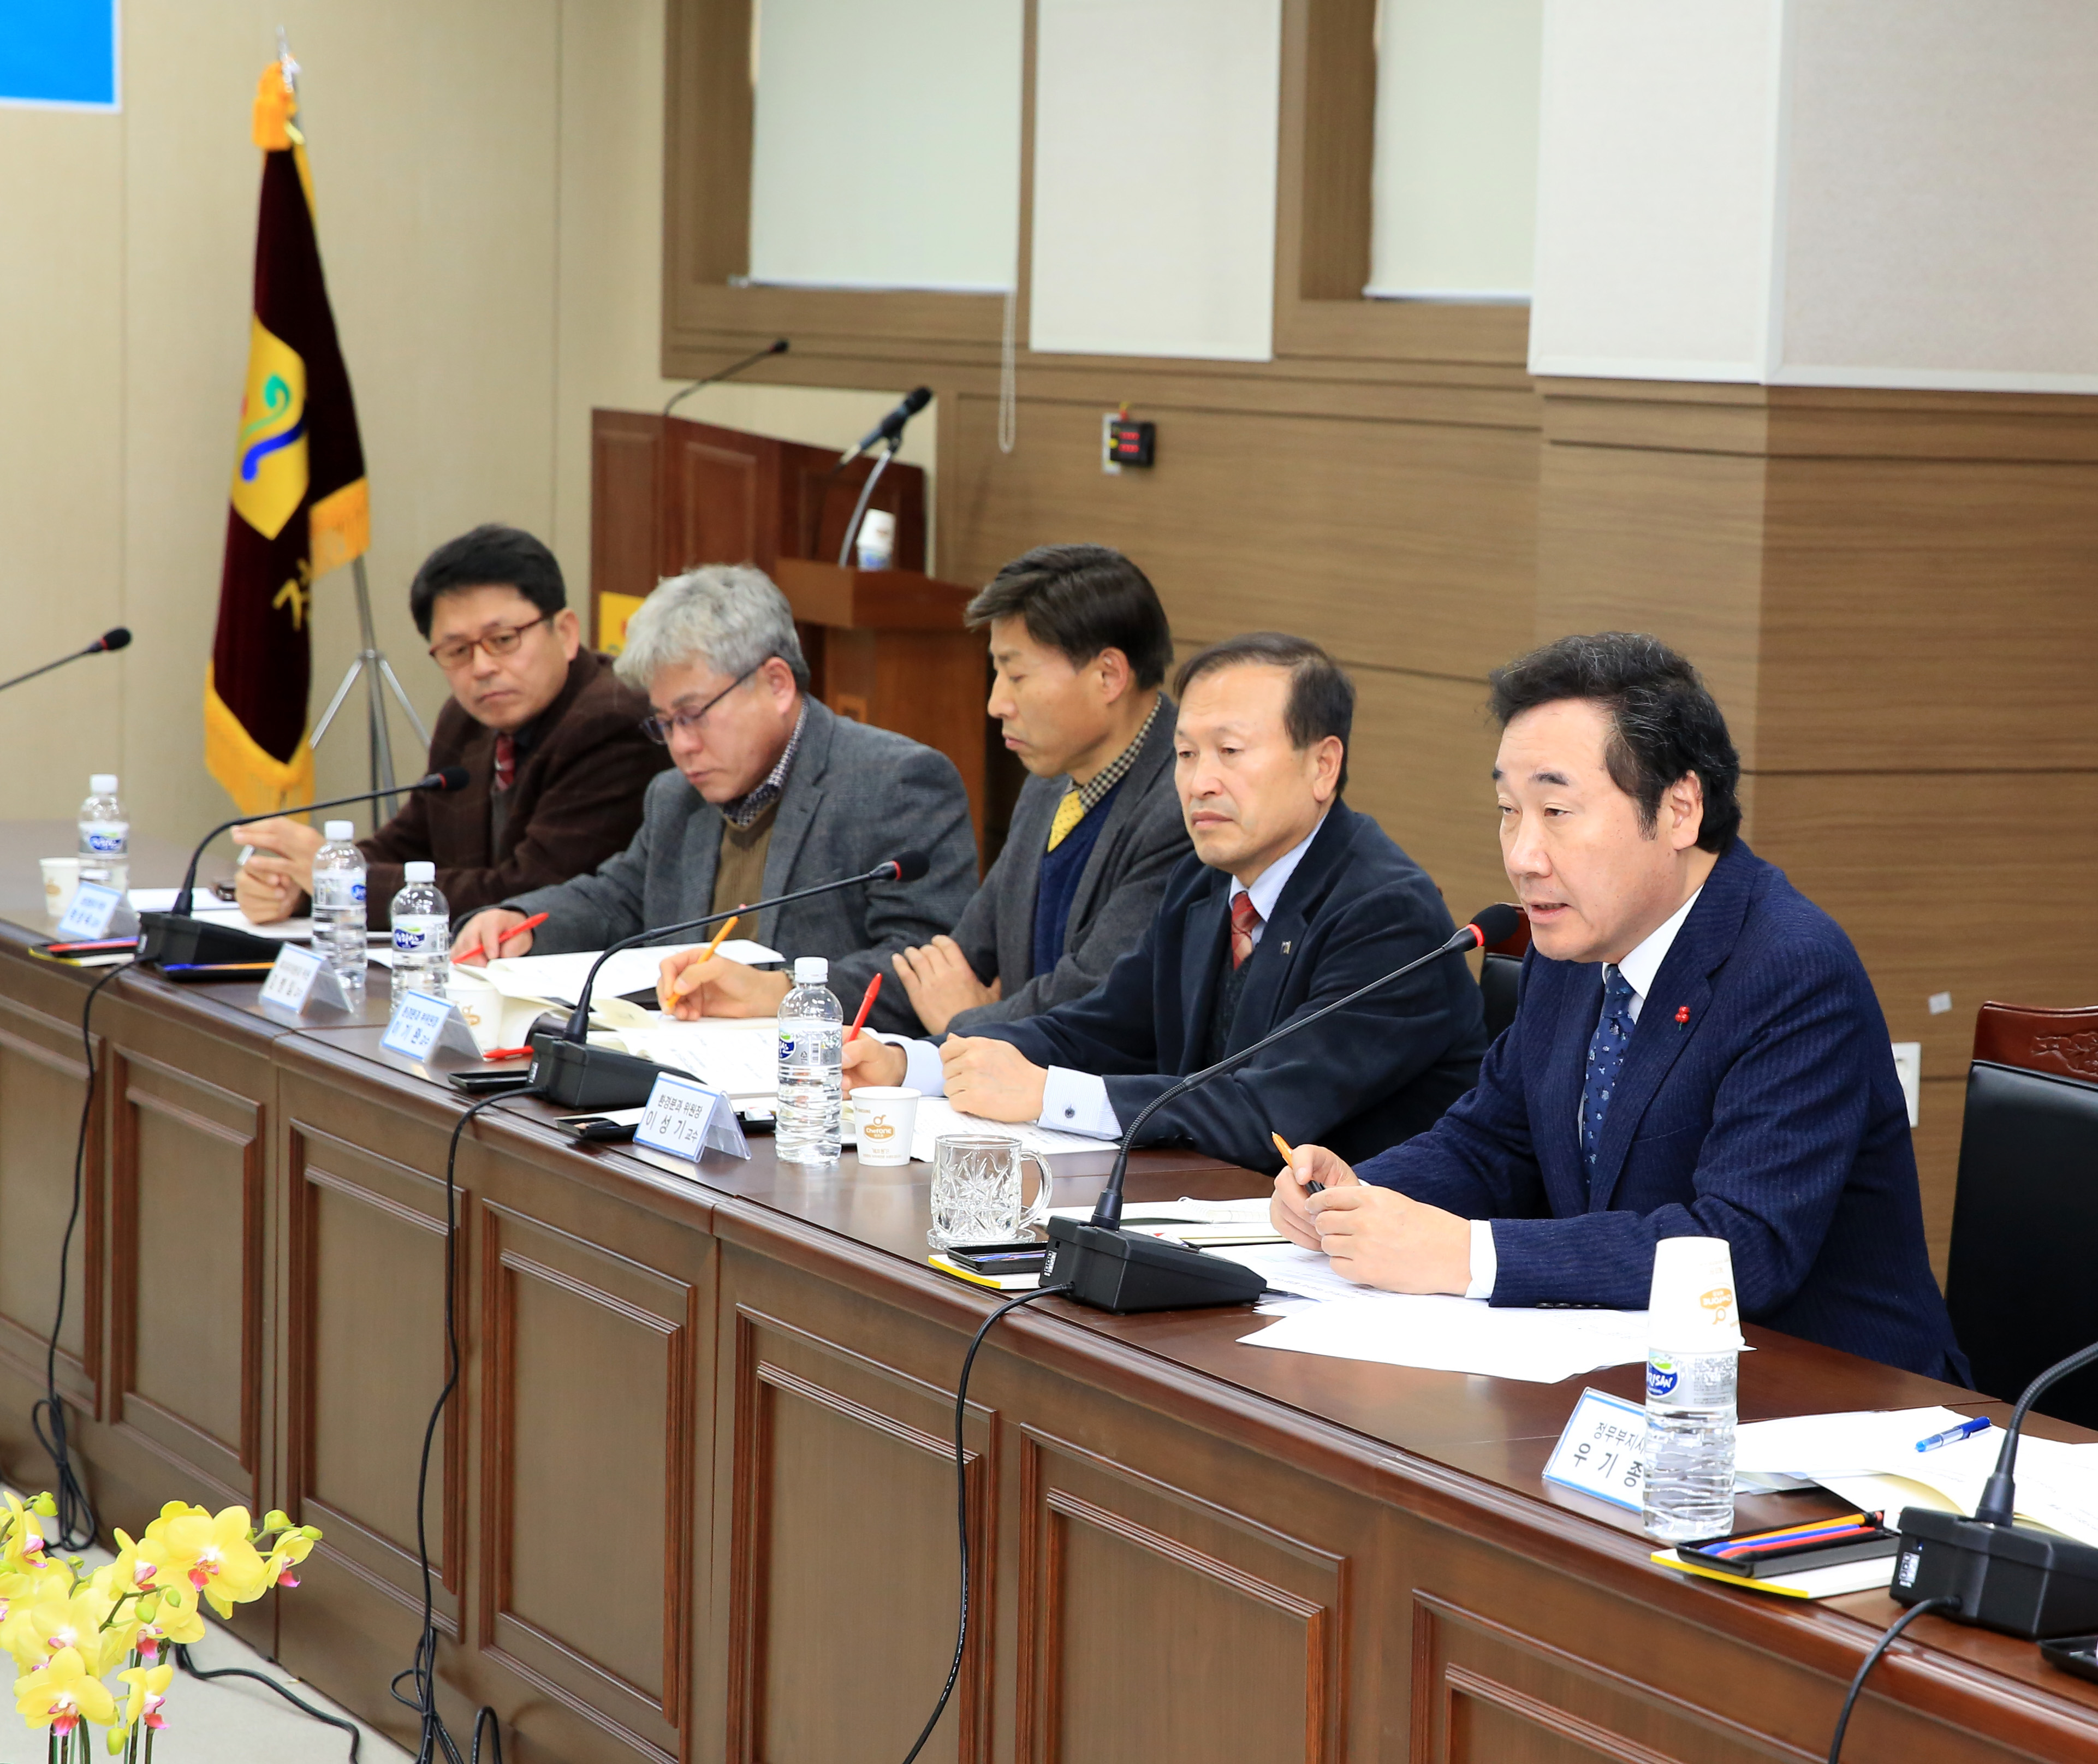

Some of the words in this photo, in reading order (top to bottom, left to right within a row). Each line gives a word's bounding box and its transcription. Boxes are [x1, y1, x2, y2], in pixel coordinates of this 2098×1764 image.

[658, 1094, 683, 1113] 환경분과
[684, 1102, 704, 1119] 위원장
[685, 1128, 699, 1143] 교수
